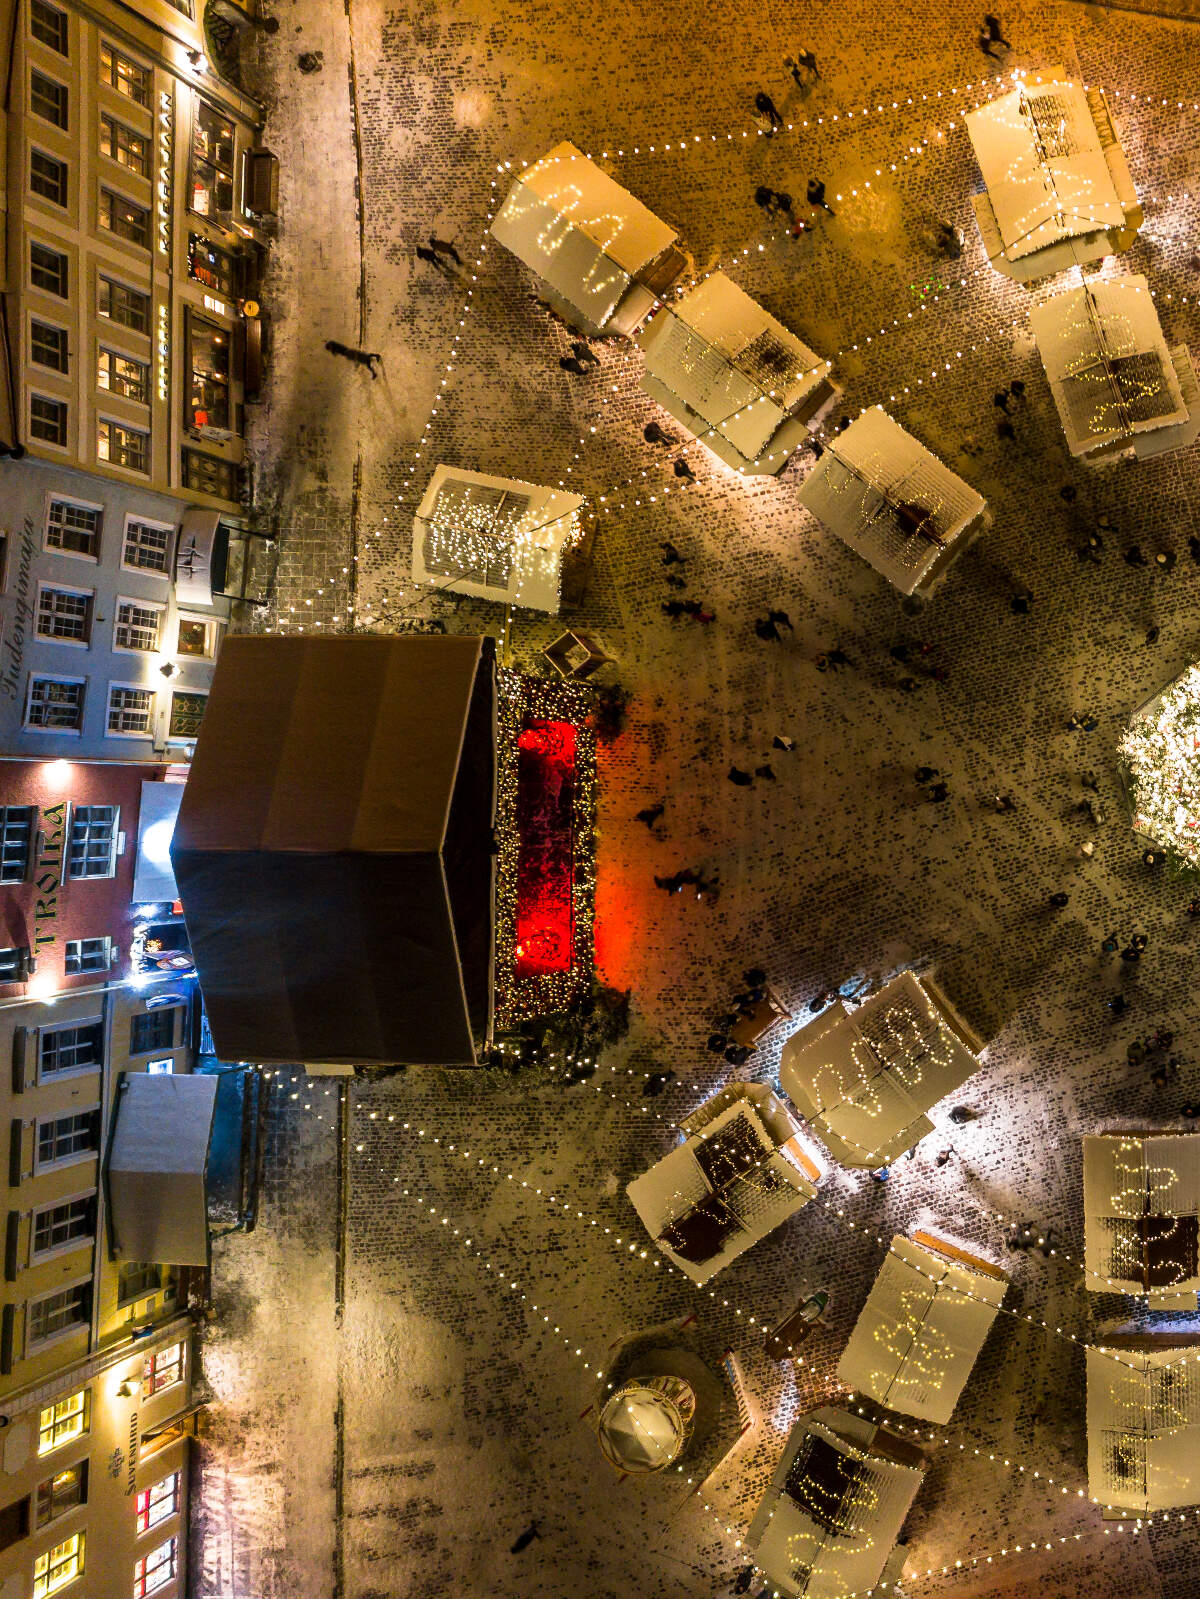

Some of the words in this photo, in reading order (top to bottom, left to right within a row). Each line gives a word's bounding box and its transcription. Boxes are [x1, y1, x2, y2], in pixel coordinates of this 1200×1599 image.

[158, 90, 172, 254] KAERAJAAN
[1, 513, 38, 700] Tudengimaja
[32, 802, 66, 955] TROIKA
